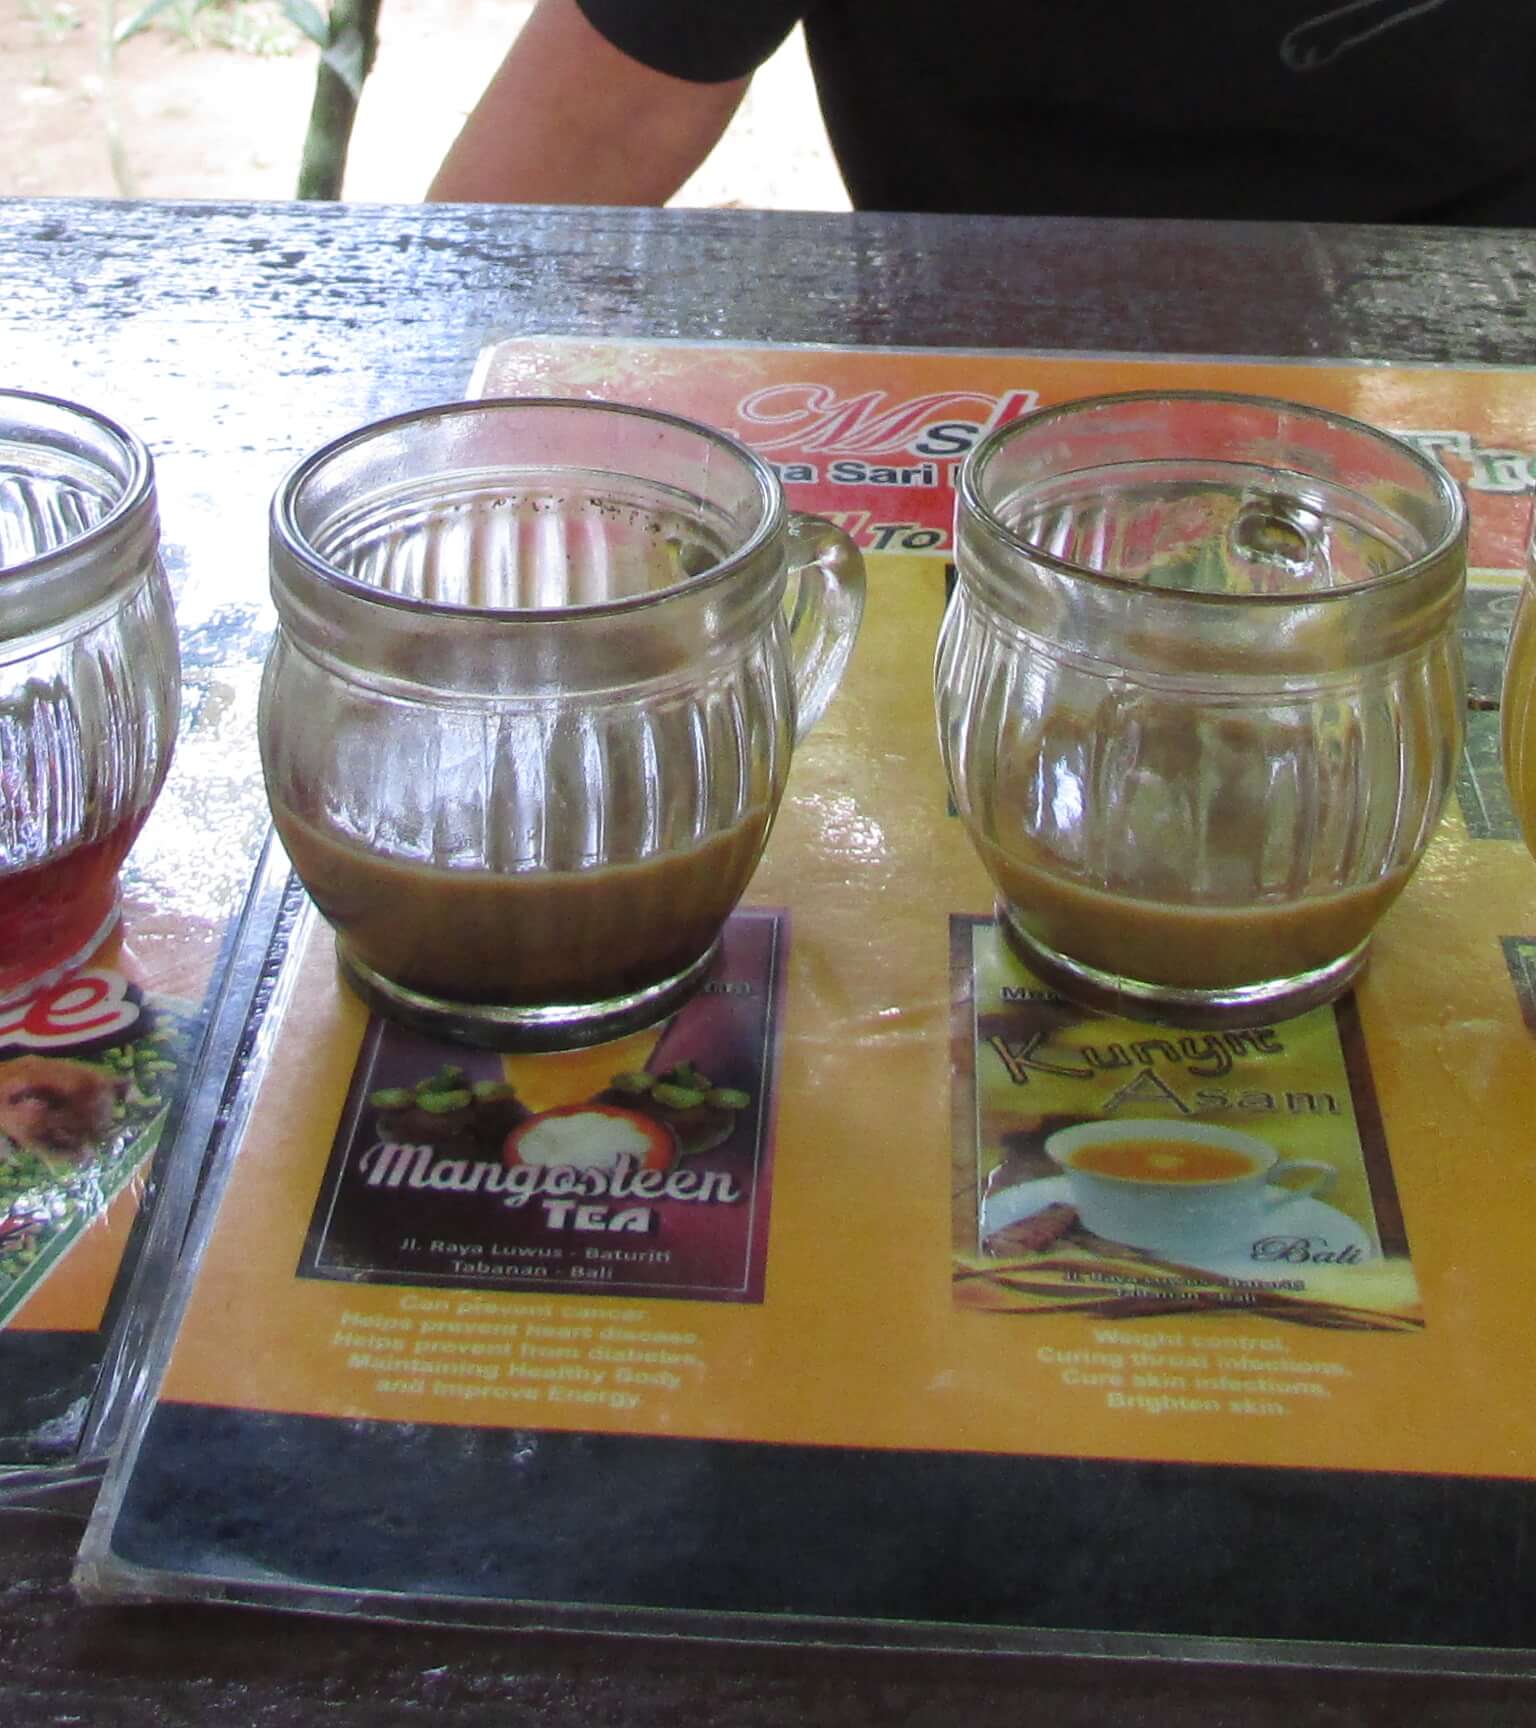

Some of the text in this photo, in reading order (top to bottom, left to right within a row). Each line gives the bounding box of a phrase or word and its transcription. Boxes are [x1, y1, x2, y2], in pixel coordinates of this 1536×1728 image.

[830, 460, 935, 487] Sari
[872, 523, 941, 551] To
[1102, 1068, 1341, 1116] Asam
[358, 1142, 743, 1208] Mangosteen
[542, 1199, 654, 1234] TEA
[430, 1239, 484, 1258] Raya
[490, 1243, 564, 1259] Luwus
[1250, 1234, 1363, 1266] Bali
[449, 1260, 549, 1278] Tabanan
[569, 1264, 613, 1281] Bali
